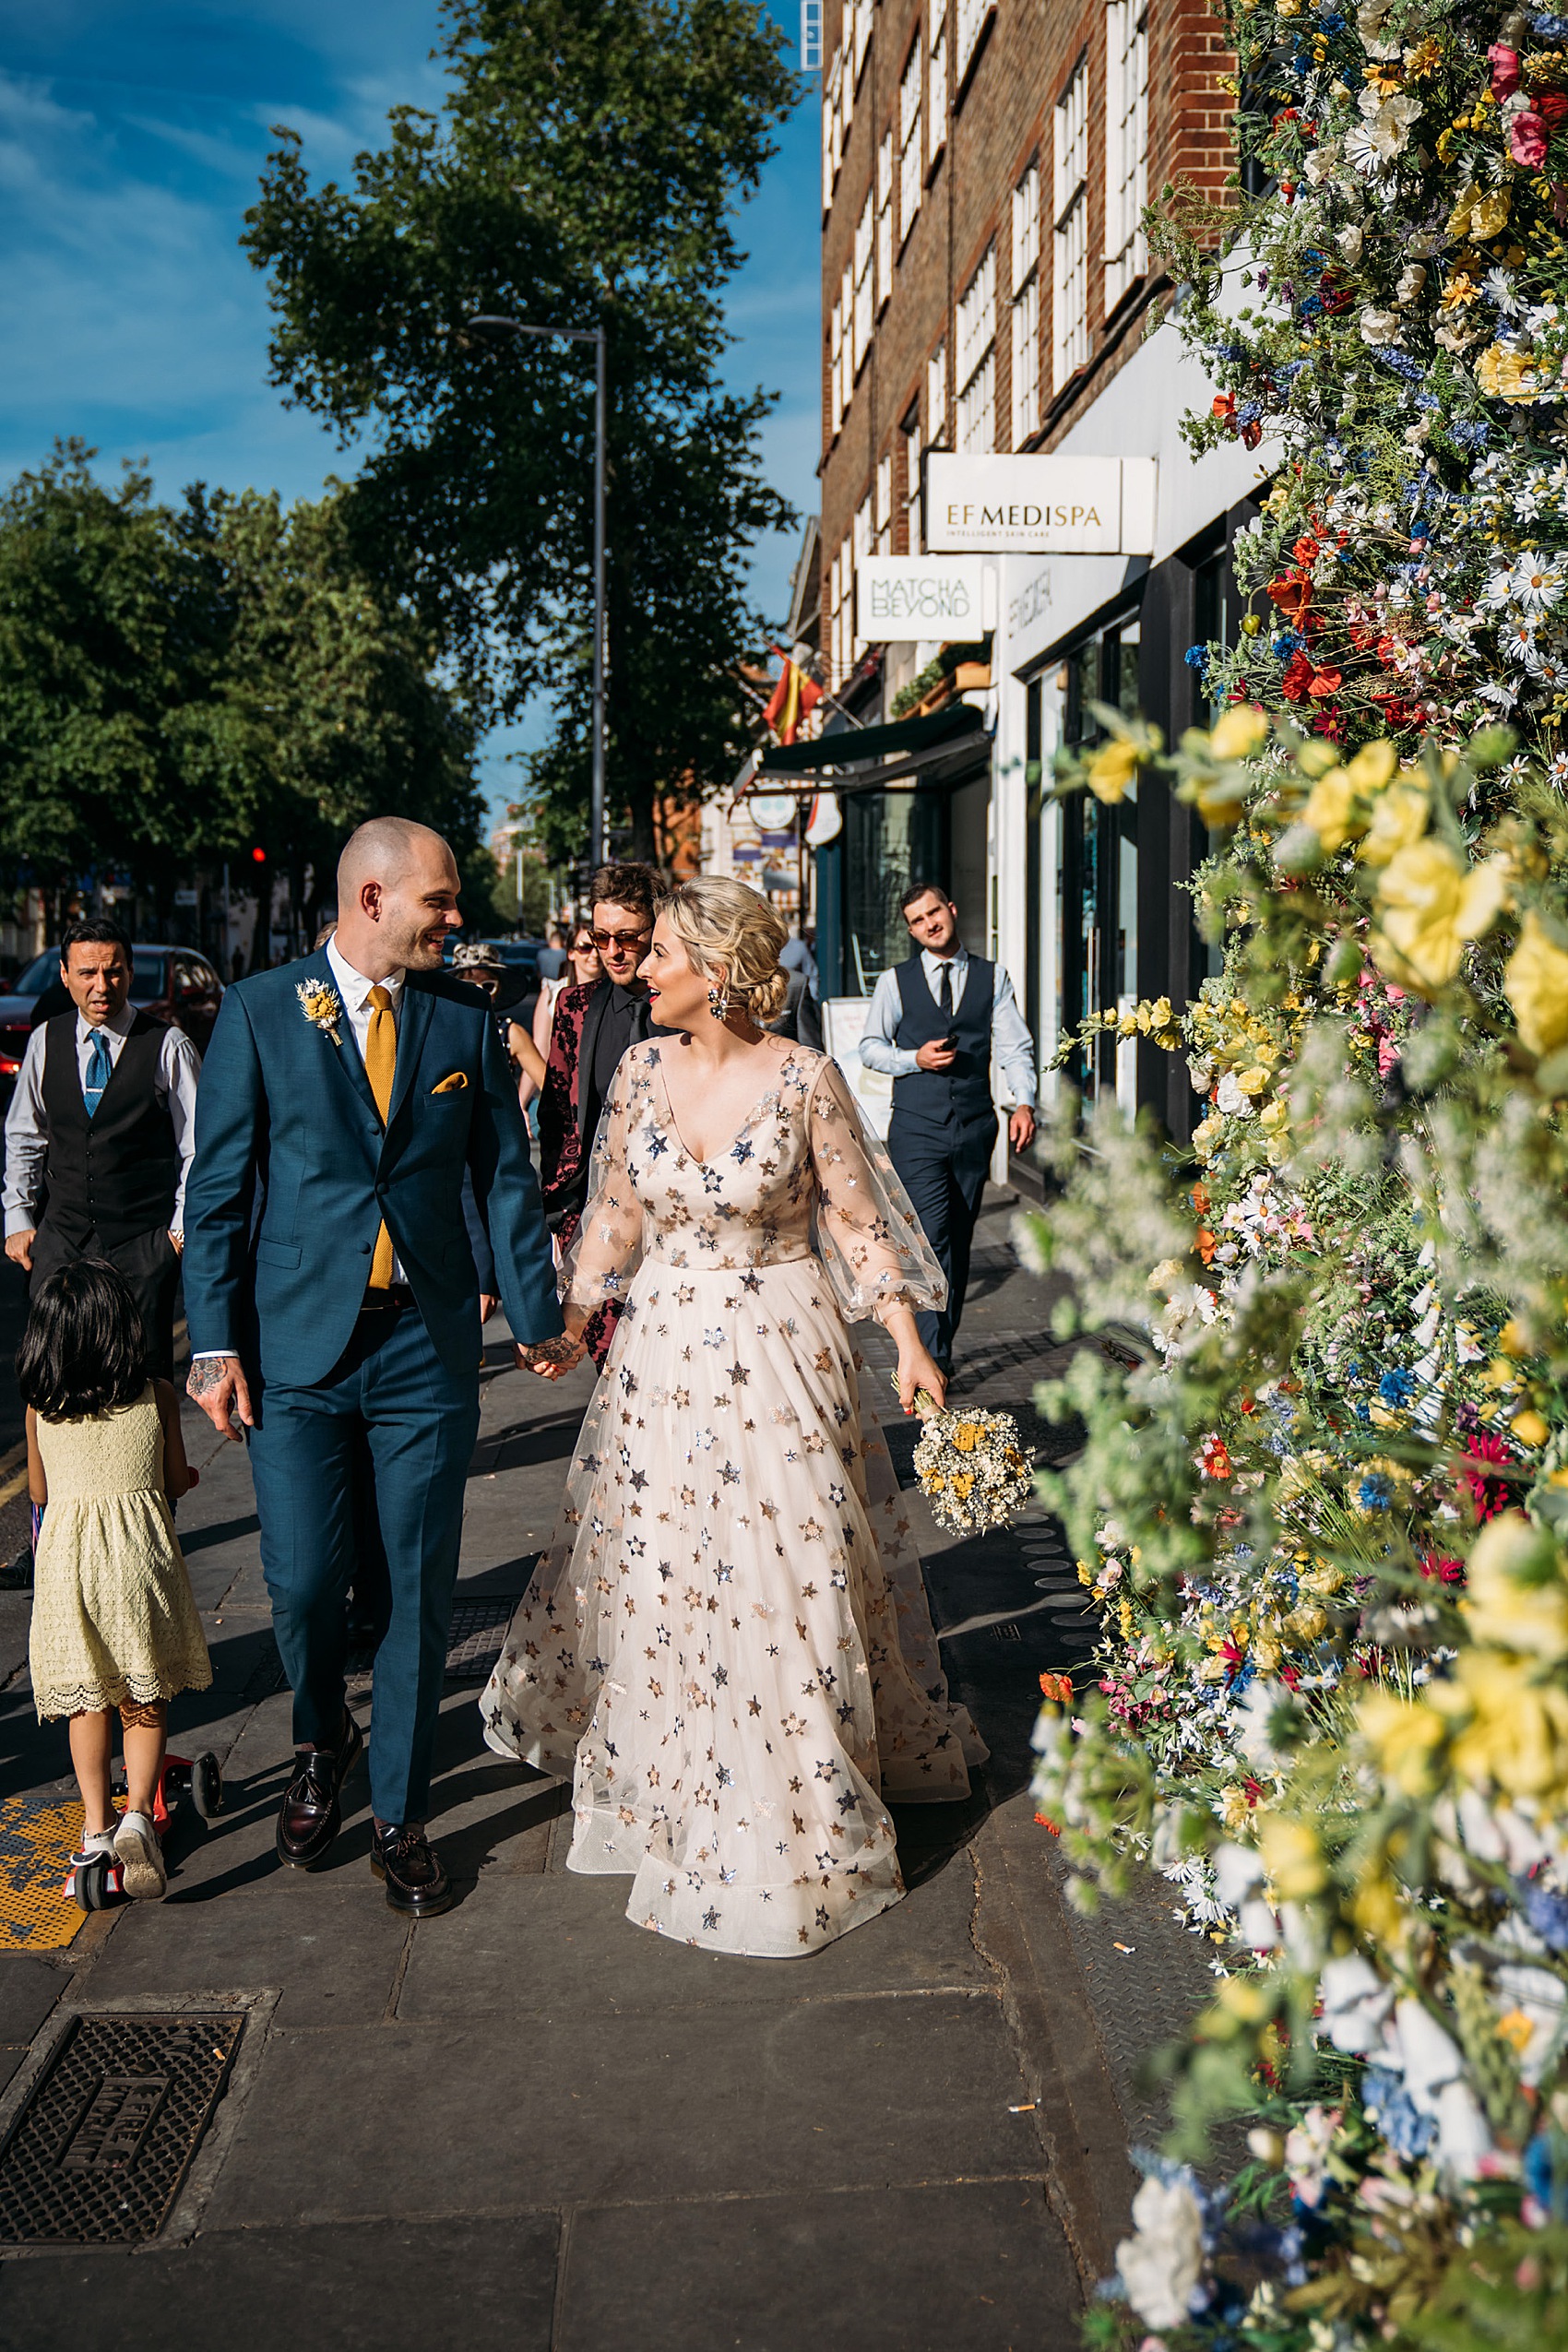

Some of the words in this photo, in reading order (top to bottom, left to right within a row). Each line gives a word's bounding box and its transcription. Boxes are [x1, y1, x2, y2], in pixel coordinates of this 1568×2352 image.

[947, 505, 976, 526] EF
[980, 505, 1102, 527] MEDISPA
[1028, 530, 1051, 539] CARE
[872, 578, 969, 599] MATCHA
[872, 598, 970, 617] BEYOND
[66, 2085, 134, 2164] HYDRANT
[110, 2103, 151, 2144] FIRE
